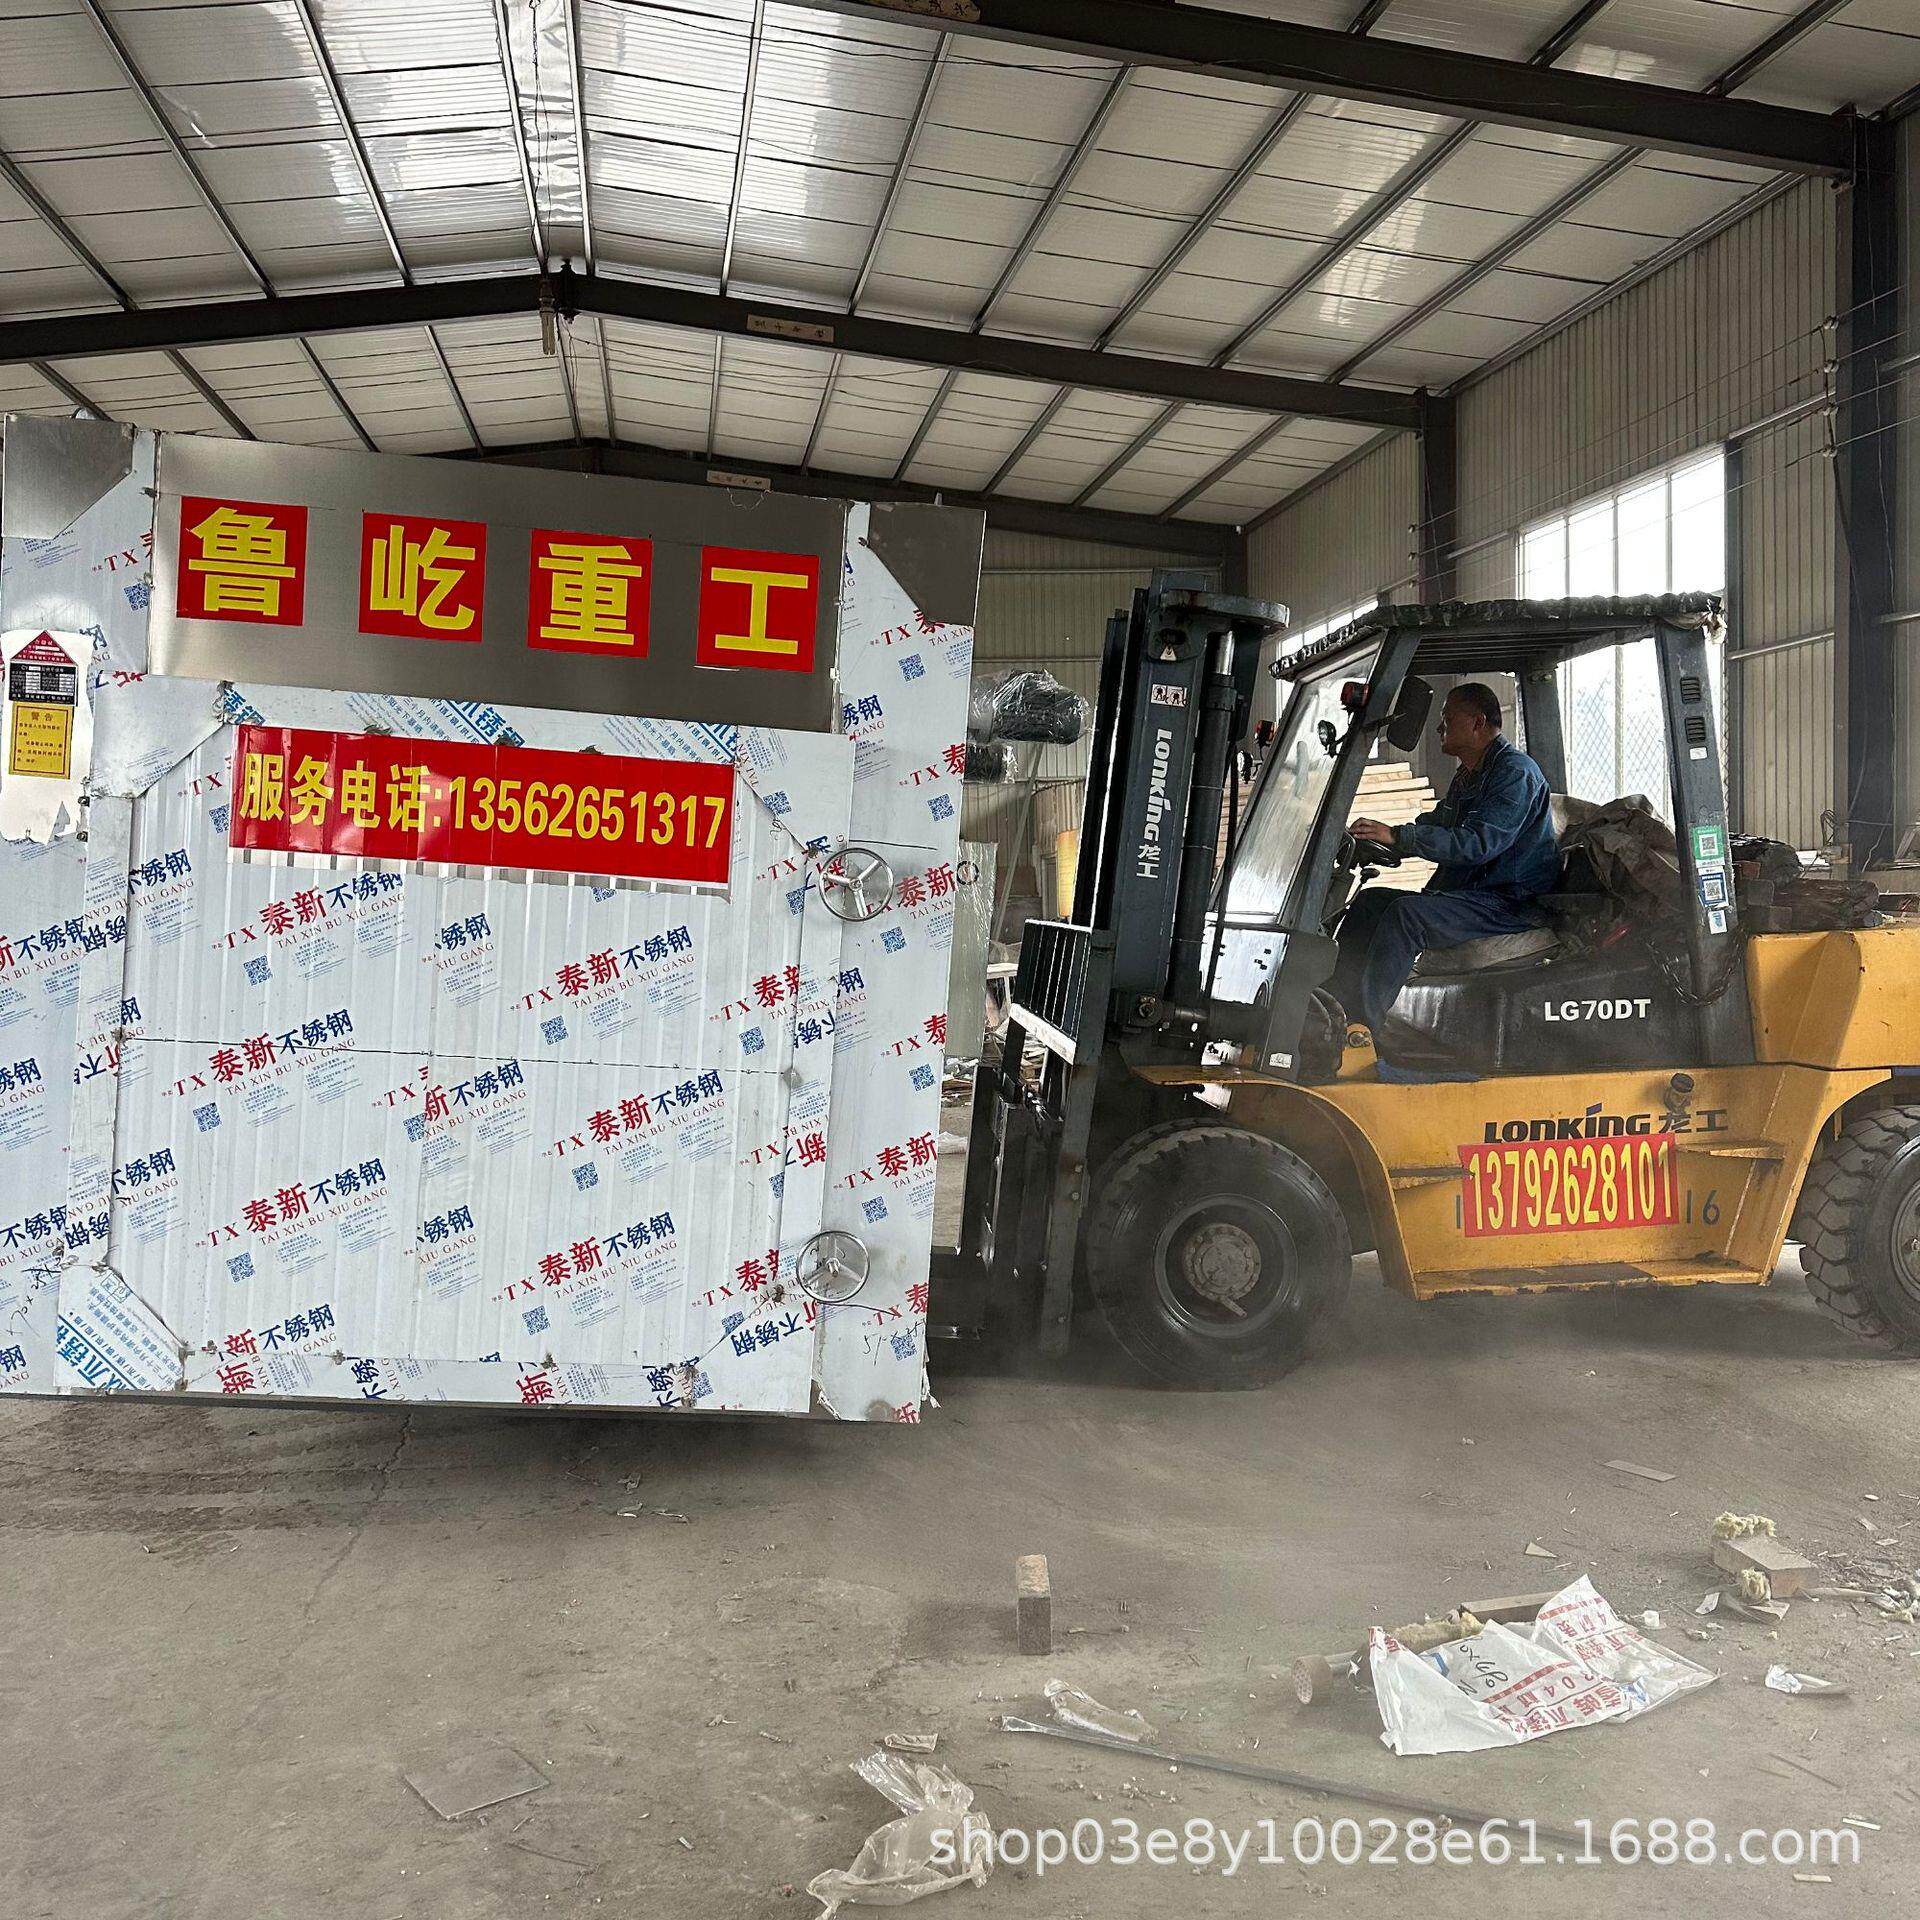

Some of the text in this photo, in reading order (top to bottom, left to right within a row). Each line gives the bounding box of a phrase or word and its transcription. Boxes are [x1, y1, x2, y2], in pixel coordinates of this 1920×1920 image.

[180, 505, 809, 656] 鲁屹重工
[240, 752, 726, 849] 服务电话:13562651317
[1544, 999, 1651, 1021] LG70DT
[1469, 1141, 1672, 1230] 13792628101
